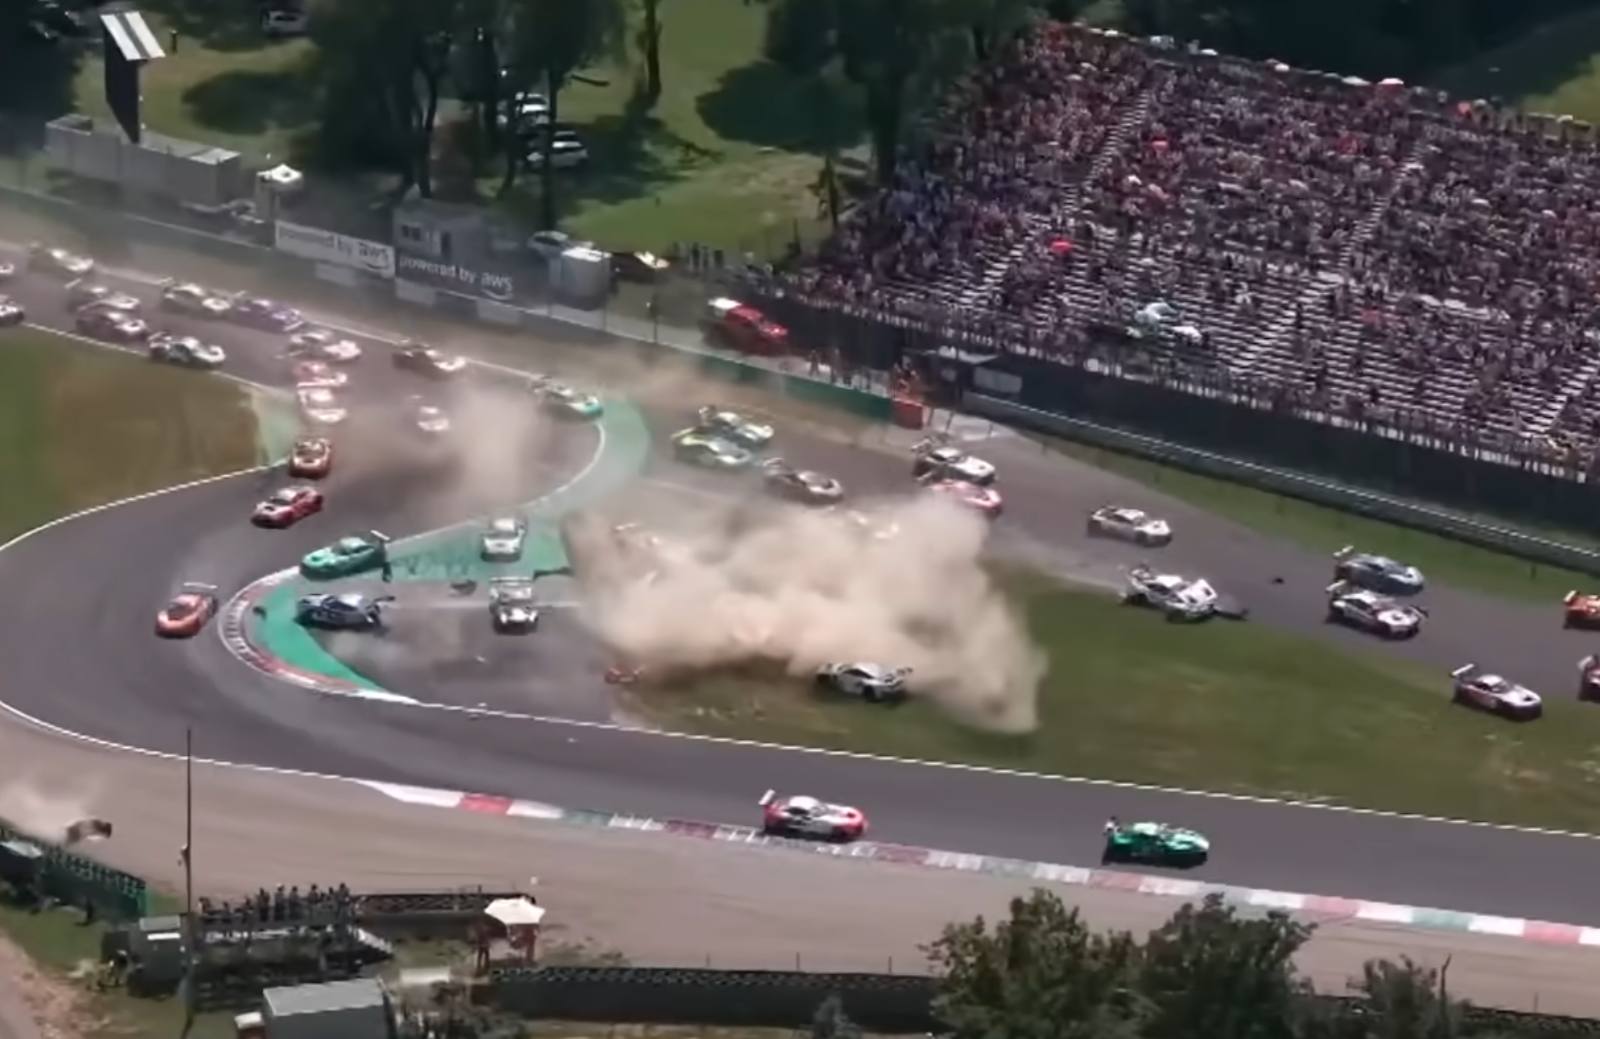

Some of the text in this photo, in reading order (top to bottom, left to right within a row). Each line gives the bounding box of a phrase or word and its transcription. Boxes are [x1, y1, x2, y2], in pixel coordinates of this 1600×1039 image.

[358, 241, 388, 263] aws
[400, 256, 512, 294] powered by aws
